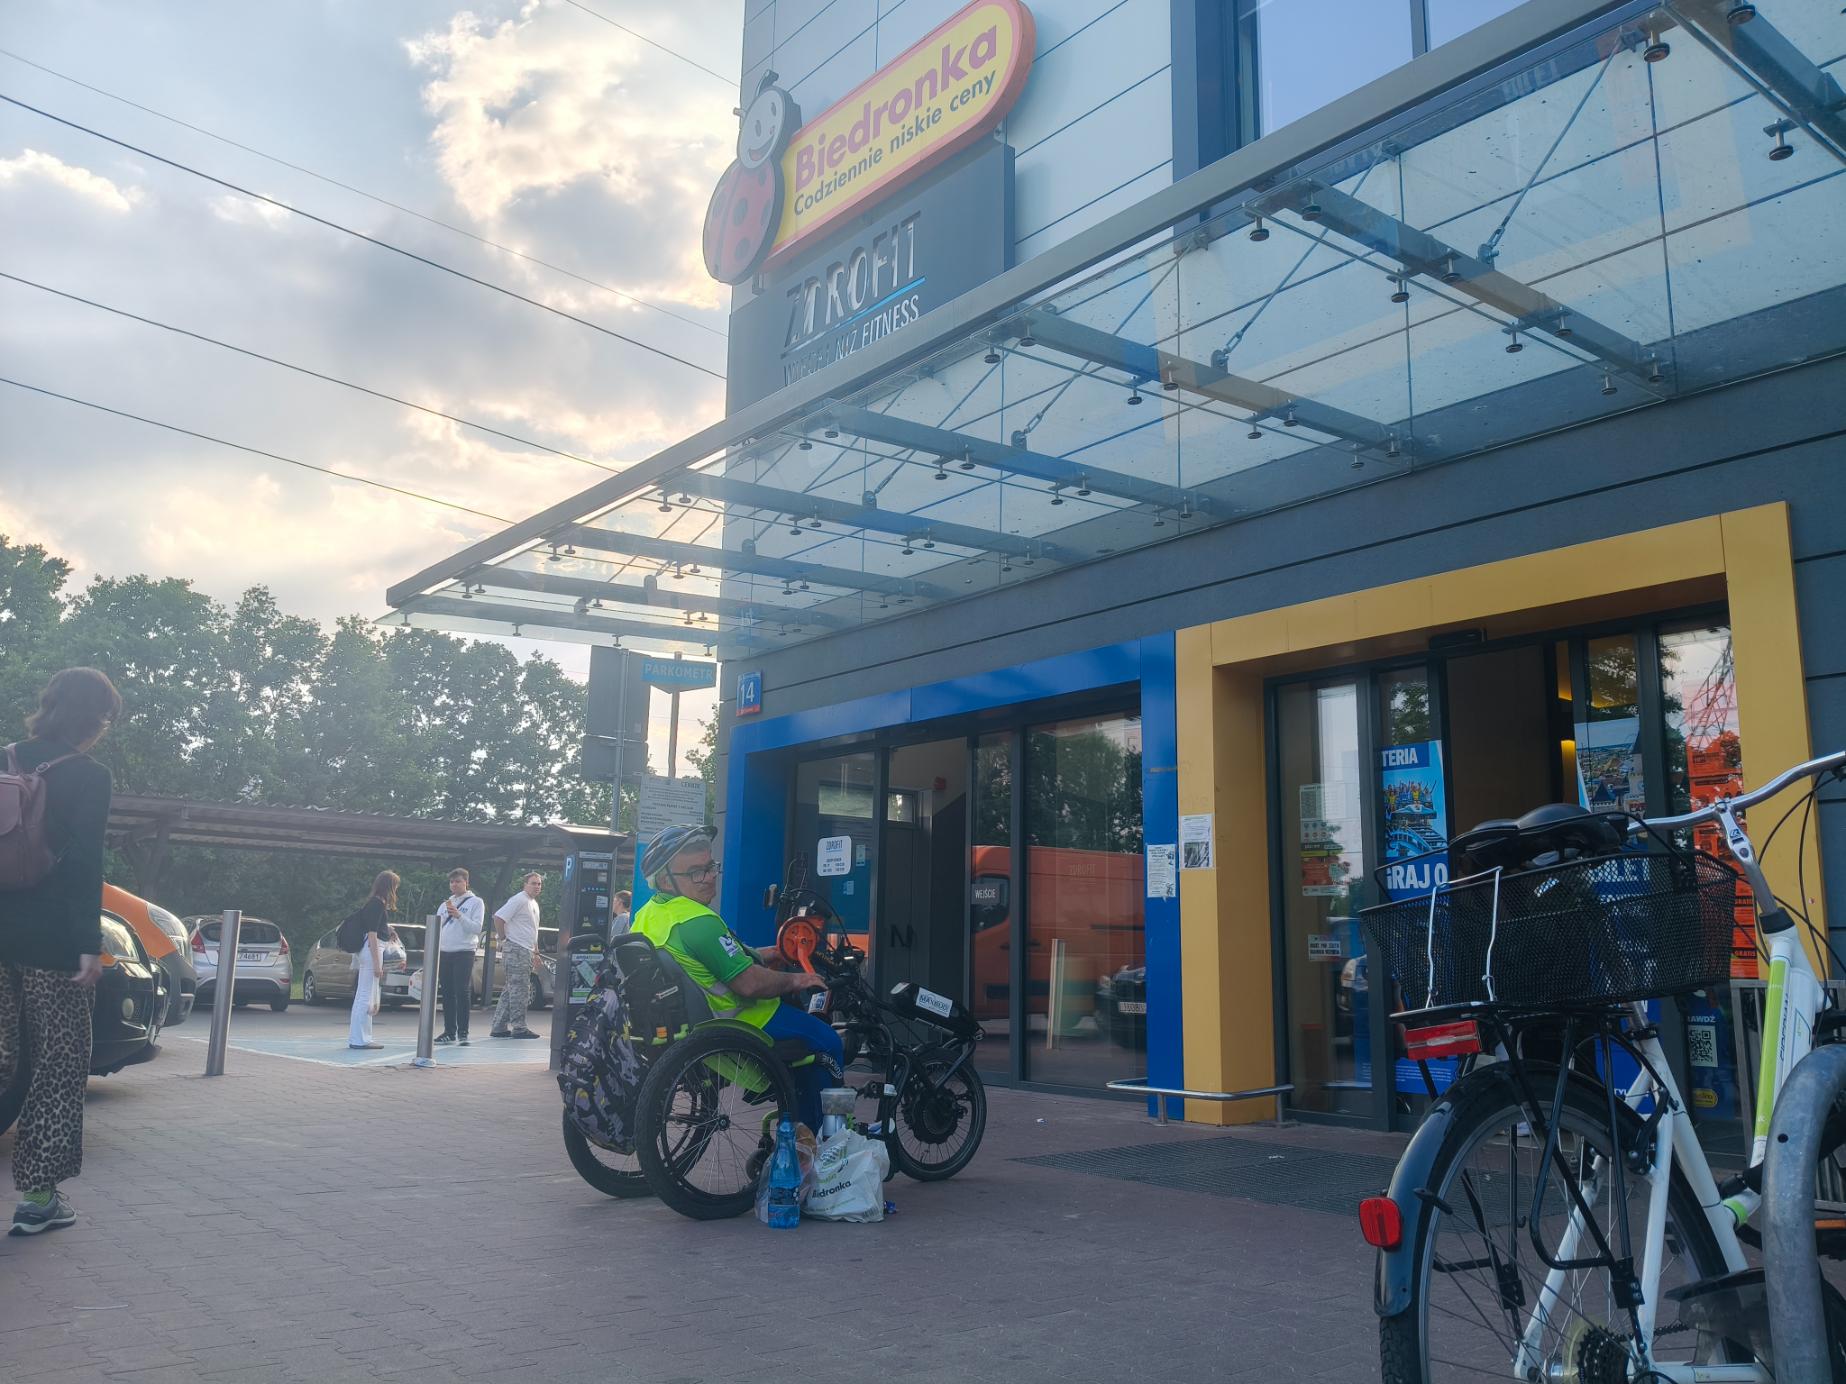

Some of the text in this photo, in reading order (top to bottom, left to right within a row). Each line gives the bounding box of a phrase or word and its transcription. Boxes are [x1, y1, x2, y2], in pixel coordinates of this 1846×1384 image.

[794, 25, 998, 193] Biedronka
[793, 70, 997, 216] Codziennie niskie ceny
[861, 294, 919, 349] FITNESS
[644, 663, 713, 681] PARKOMETR
[740, 681, 755, 708] 14
[1382, 747, 1418, 767] TERIA
[975, 887, 996, 899] WEJŚCIE
